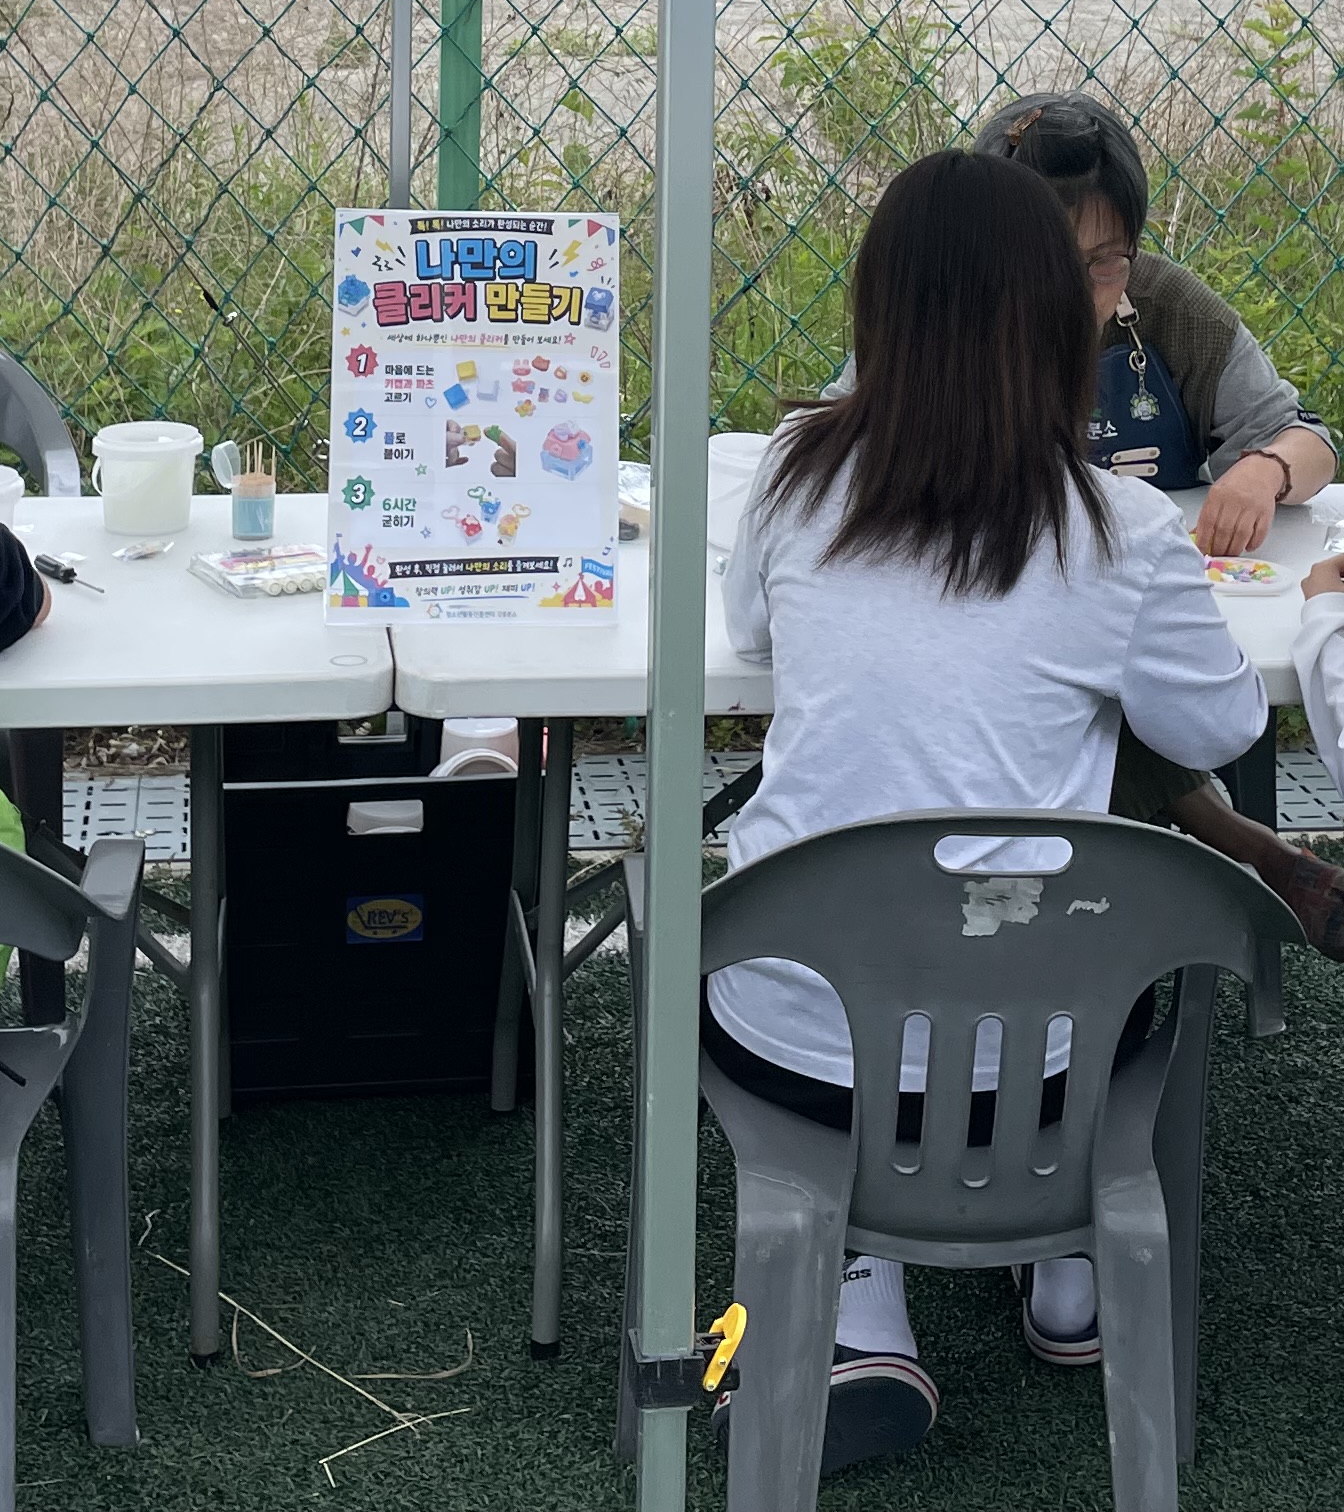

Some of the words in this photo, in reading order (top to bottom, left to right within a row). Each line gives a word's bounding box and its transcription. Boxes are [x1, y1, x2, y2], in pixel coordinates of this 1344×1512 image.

[446, 219, 470, 229] 나만의
[472, 218, 495, 229] 소리가
[415, 238, 538, 282] 나만의
[373, 280, 477, 327] 클리커
[484, 282, 584, 326] 만들기
[416, 333, 447, 344] 하나뿐인
[451, 333, 476, 343] 나만의
[512, 334, 534, 345] 만들어
[357, 352, 368, 373] 1
[384, 364, 413, 376] 마음에
[416, 365, 434, 376] 드는
[384, 392, 412, 403] 고르기
[352, 415, 368, 437] 2
[383, 448, 414, 460] 붙이기
[351, 483, 367, 505] 3
[382, 497, 417, 512] 6시간
[382, 514, 414, 528] 굳히기
[465, 561, 491, 573] 나만의
[440, 585, 455, 595] UP!
[484, 584, 499, 594] UP!
[520, 582, 536, 592] UP!
